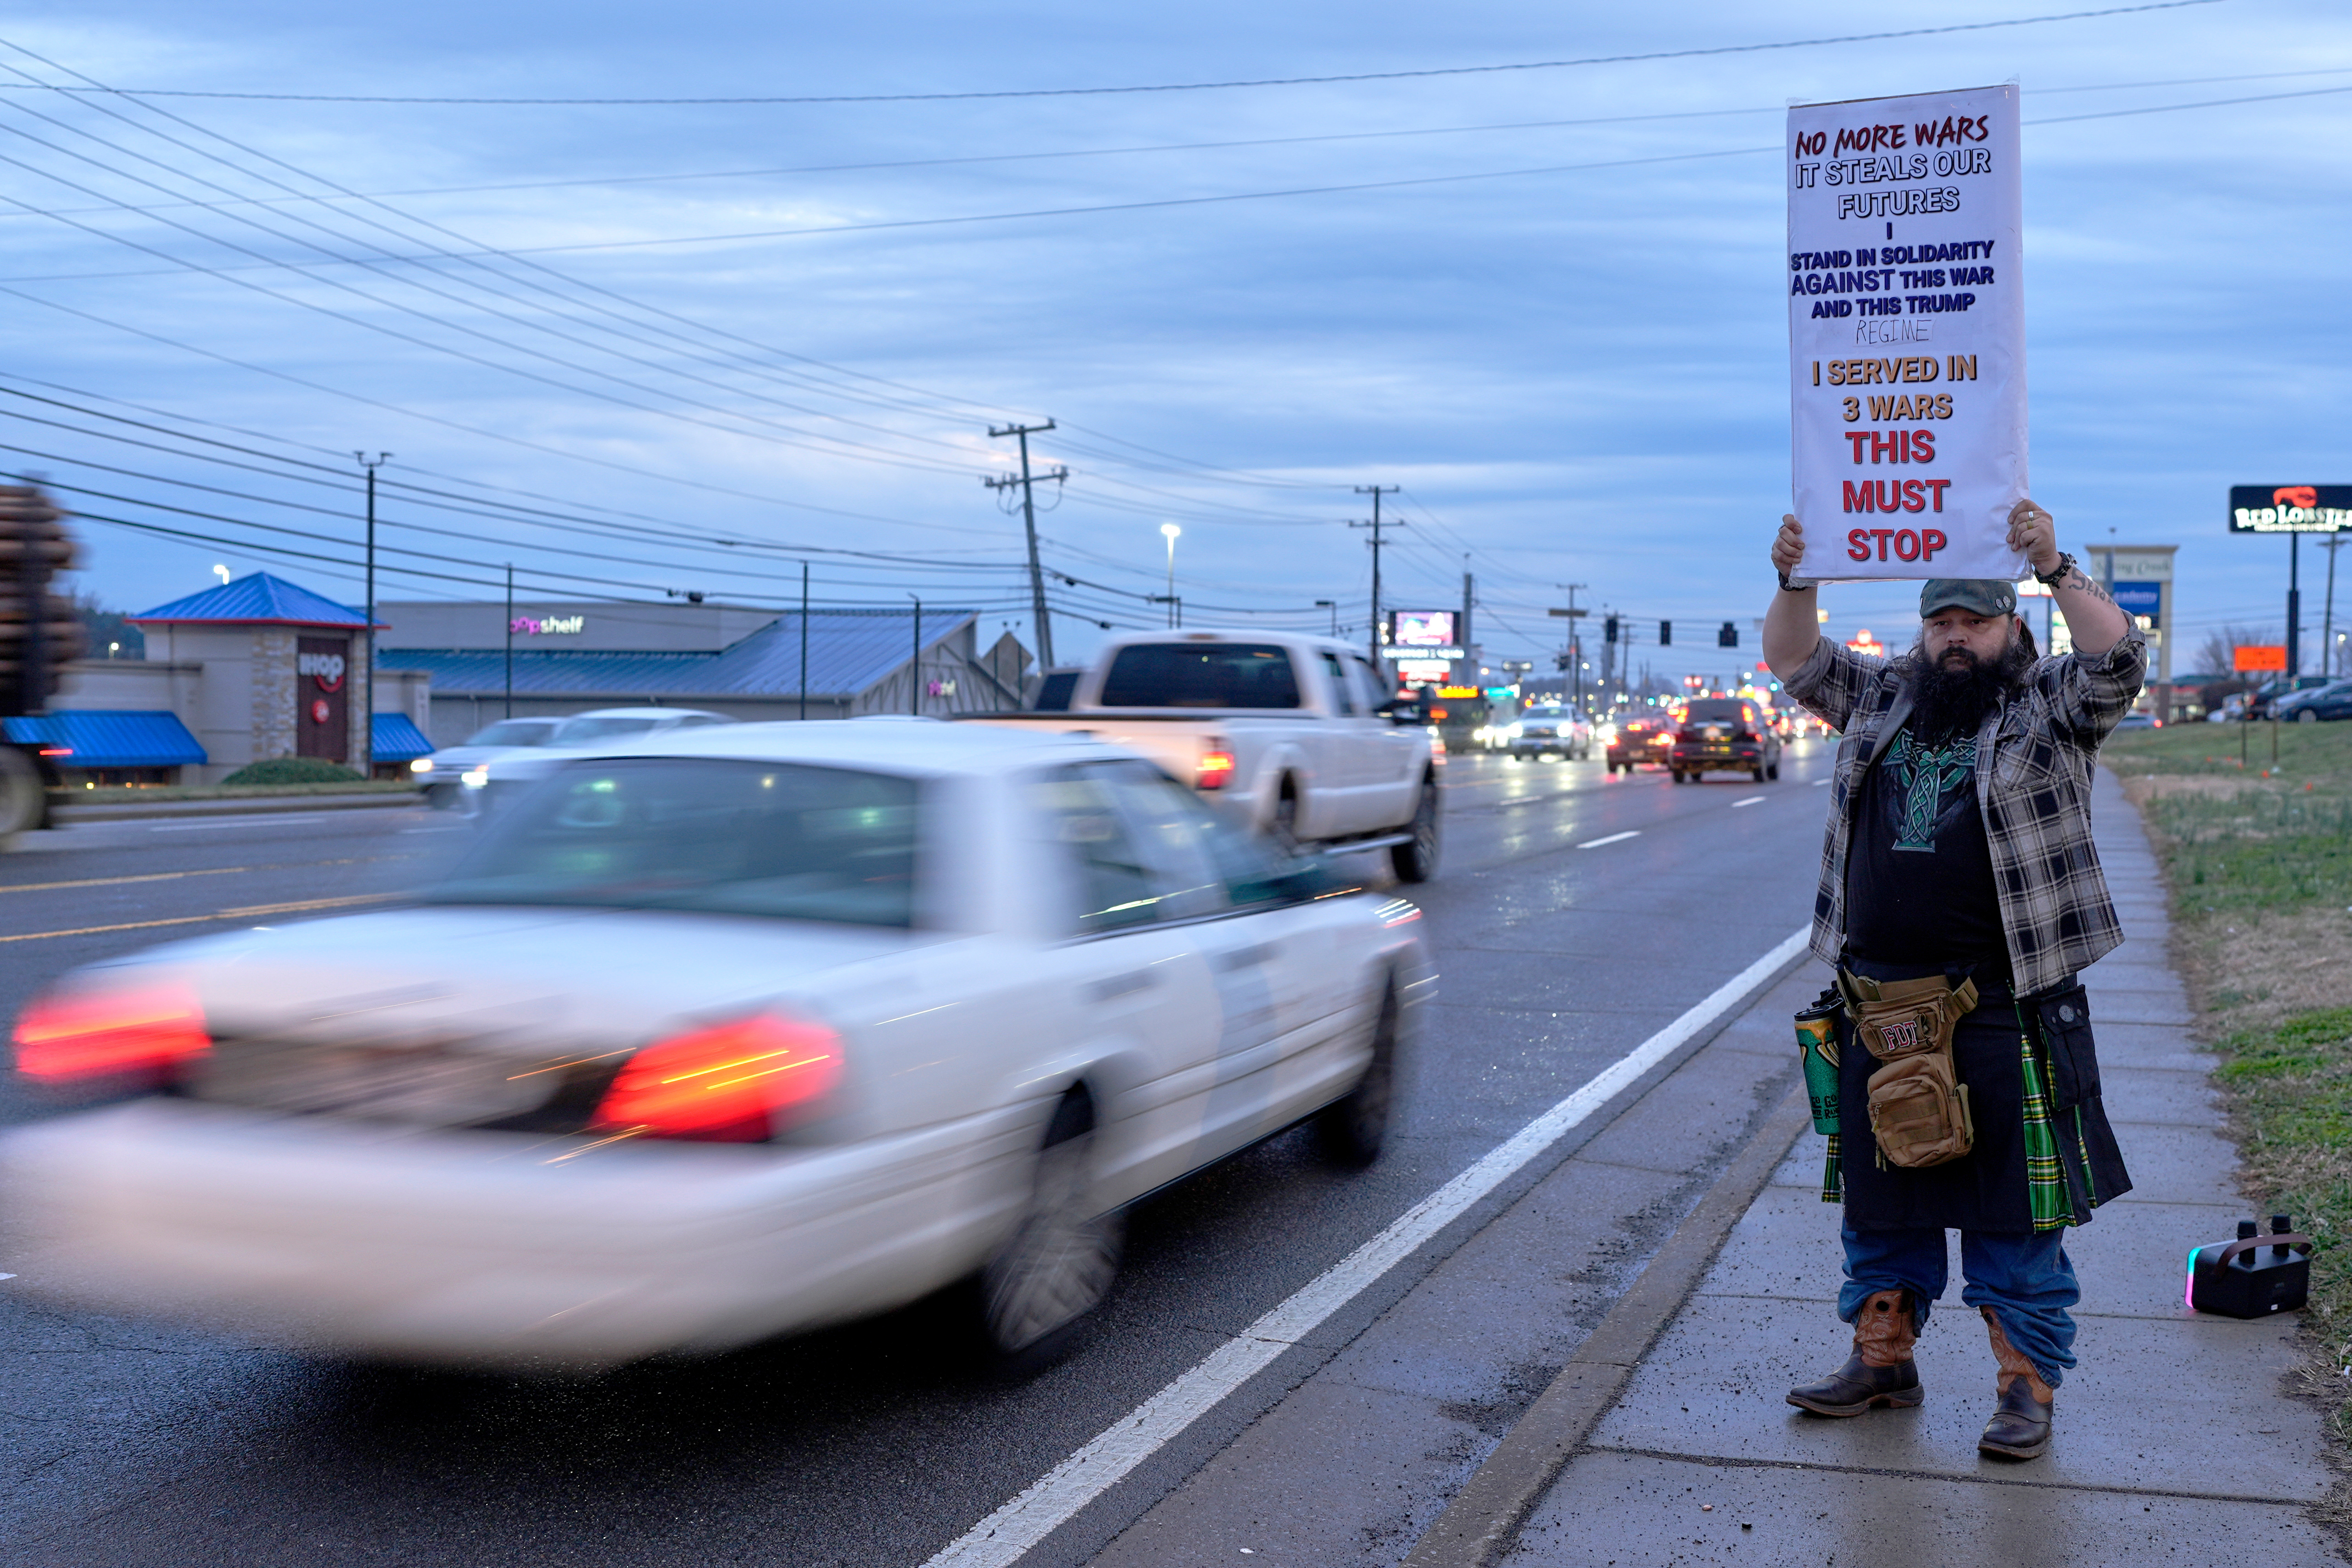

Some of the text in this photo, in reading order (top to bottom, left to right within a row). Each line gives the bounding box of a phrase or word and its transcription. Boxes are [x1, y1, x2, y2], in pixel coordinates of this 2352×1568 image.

[1795, 115, 1989, 159] NO MORE WARS
[1795, 148, 1991, 188] IT STEALS OUR
[1839, 187, 1959, 219] FUTURES
[1887, 222, 1892, 240] I
[1791, 240, 1994, 271] STAND IN SOLIDARITY
[1791, 266, 1994, 296] AGAINST THIS WAR
[1811, 293, 1976, 318] AND THIS TRUMP
[1856, 319, 1932, 344] REGIME
[1813, 354, 1978, 386] I SERVED IN
[1842, 393, 1953, 422] 3 WARS
[1844, 429, 1935, 464] THIS
[1842, 478, 1951, 513] MUST
[1847, 528, 1947, 561] STOP
[1881, 1020, 1917, 1050] FDT
